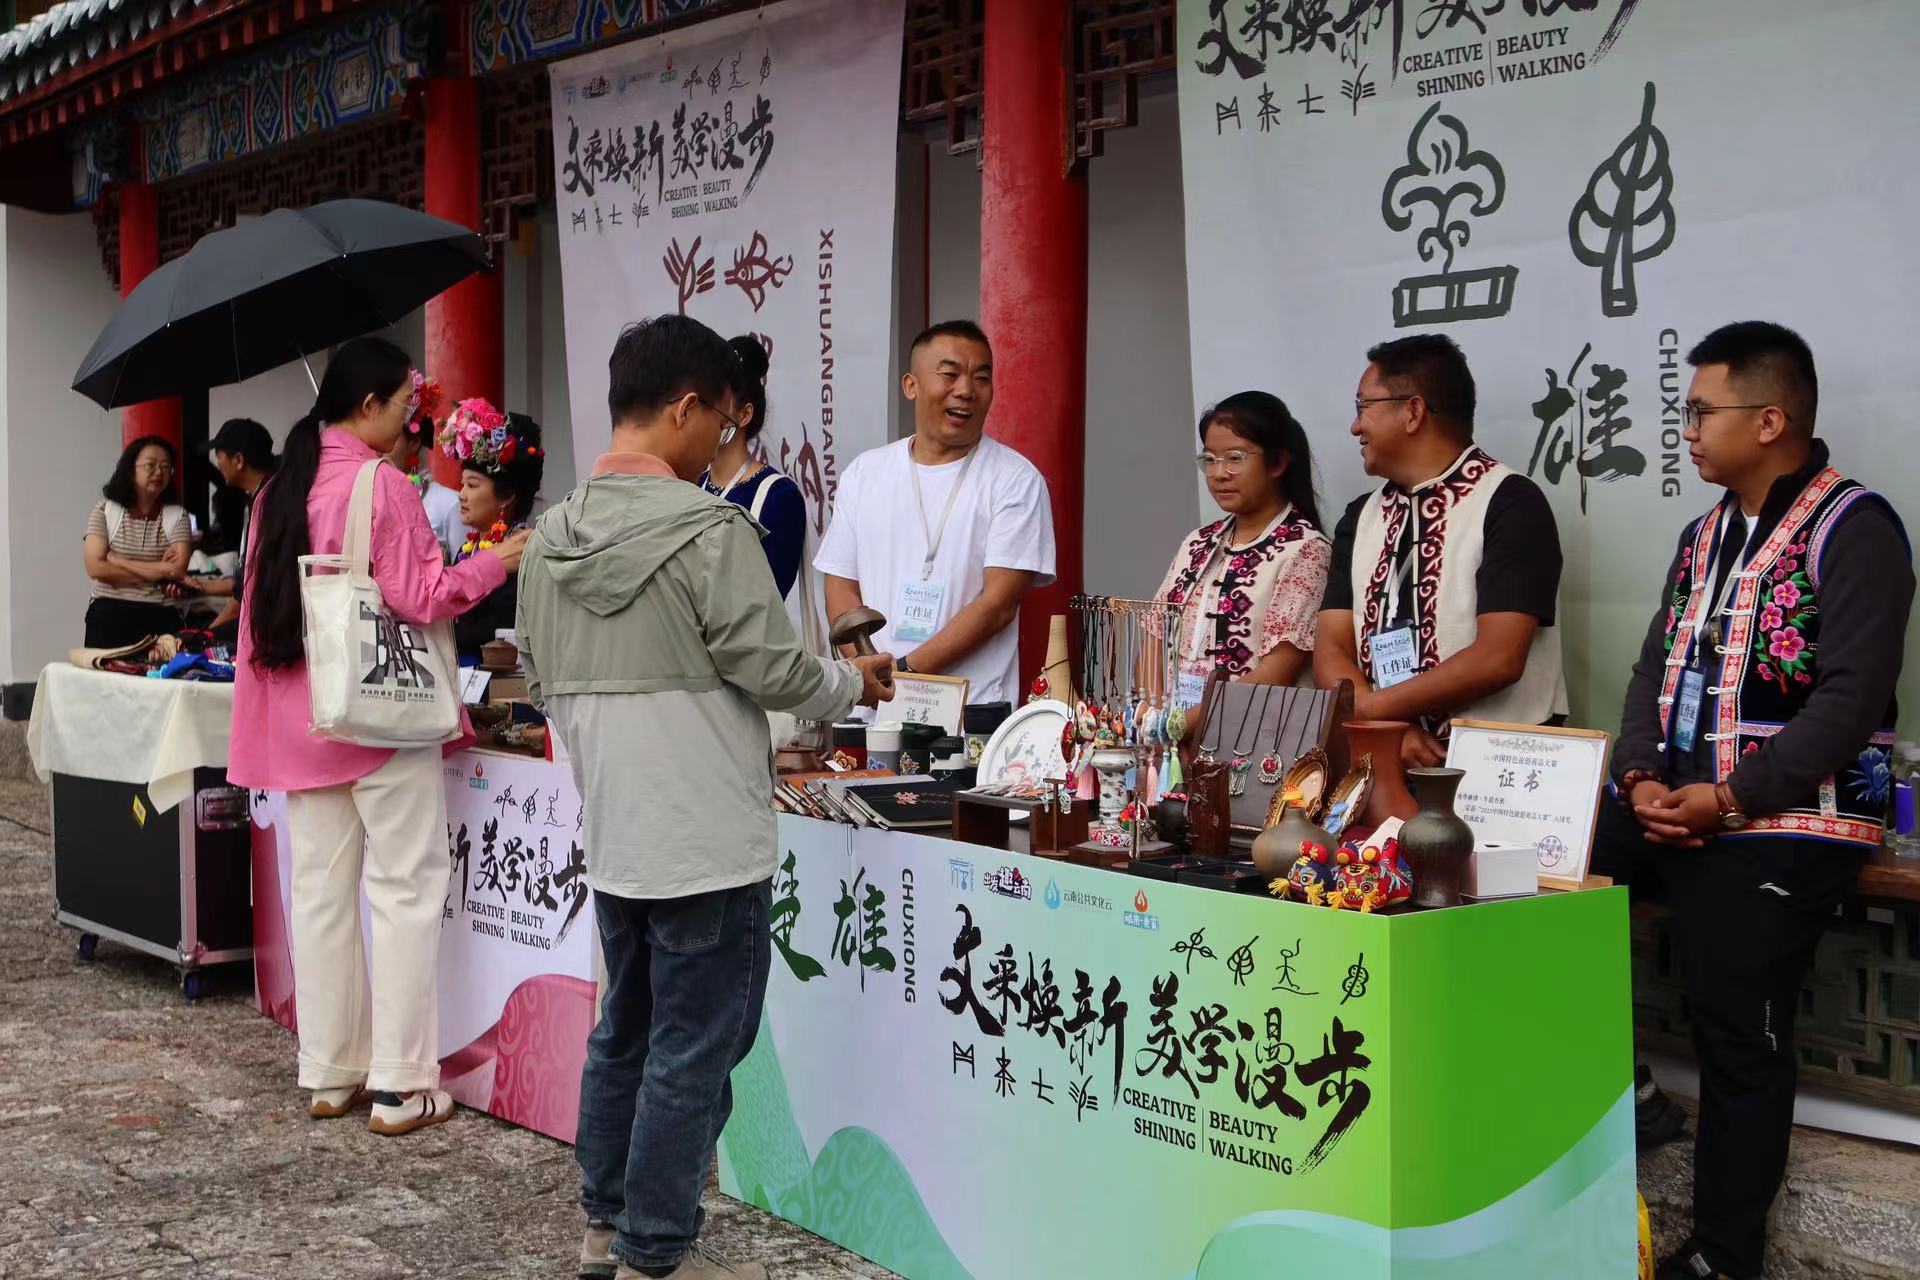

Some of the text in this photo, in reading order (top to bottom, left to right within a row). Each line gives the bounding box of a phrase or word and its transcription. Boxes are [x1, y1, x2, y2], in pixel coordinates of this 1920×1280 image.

[1403, 27, 1569, 74] CREATIVE BEAUTY
[1417, 52, 1587, 98] SHINING WALKING
[664, 178, 732, 203] CREATIVE BEAUTY
[671, 196, 738, 219] SHINING WALKING
[818, 228, 838, 519] XISHUANGBANN
[1527, 342, 1647, 515] 雄
[1659, 327, 1681, 498] CHUXIONG
[466, 900, 545, 930] CREATIVE BEAUTY
[1063, 888, 1113, 912] 云南公共文化云
[472, 919, 551, 951] SHINING WALKING
[902, 868, 916, 1004] CHUXIONG
[1123, 1087, 1278, 1144] CREATIVE BEAUTY
[1134, 1117, 1293, 1176] SHINING WALKING
